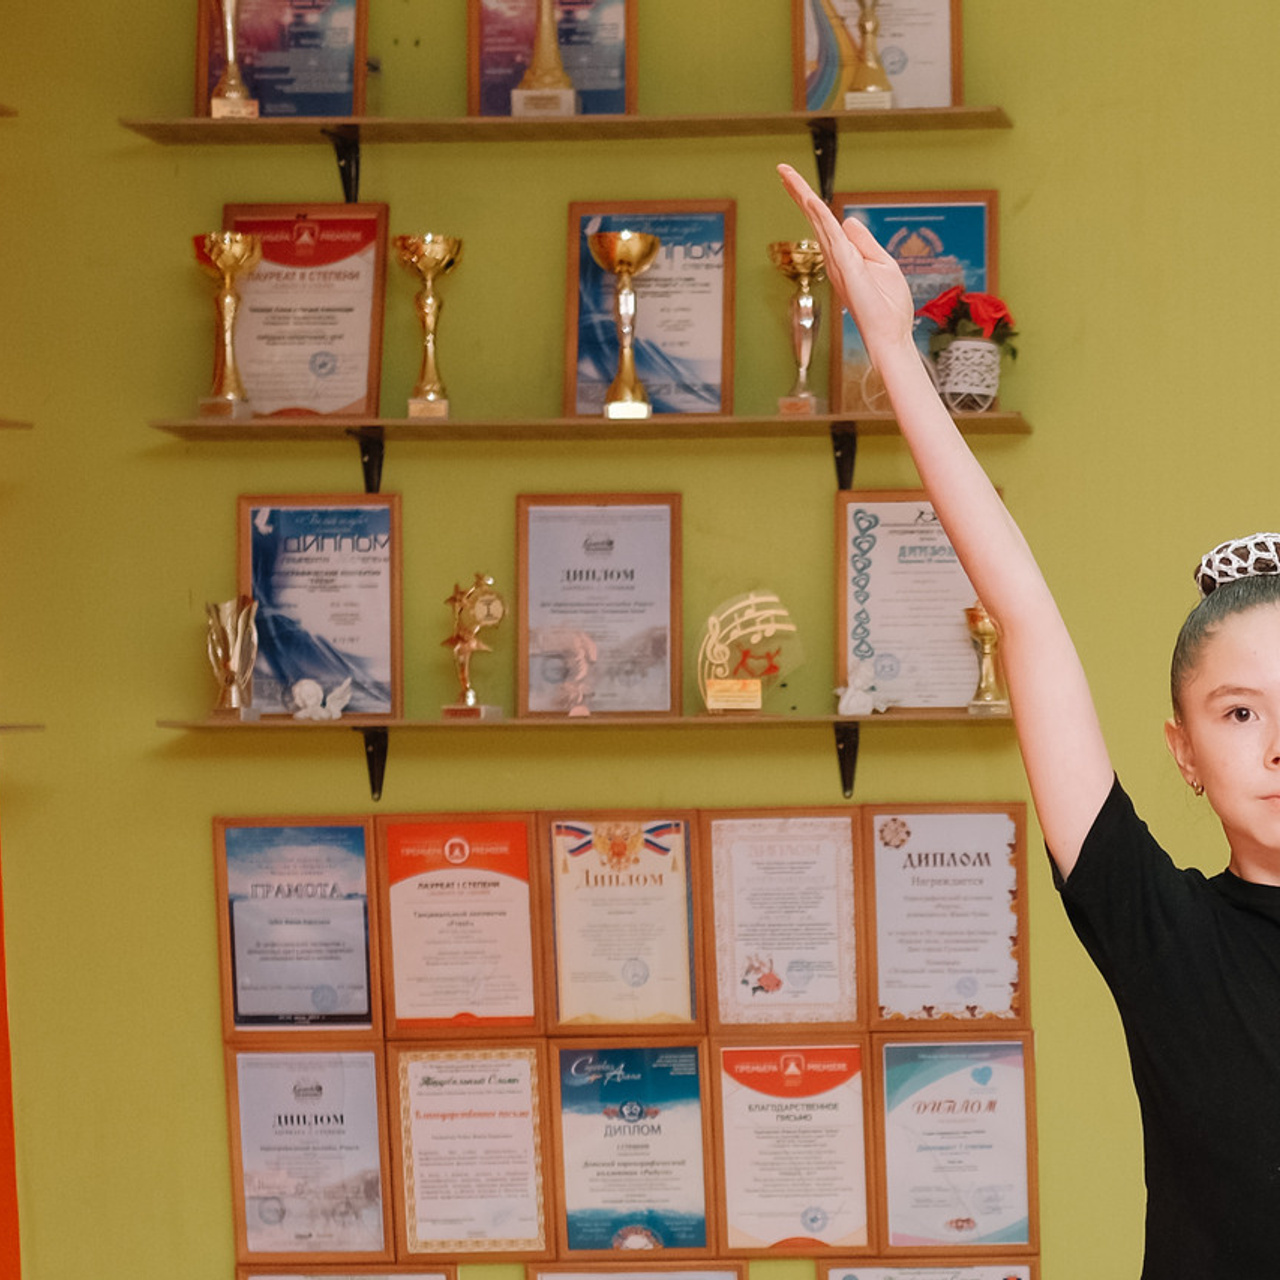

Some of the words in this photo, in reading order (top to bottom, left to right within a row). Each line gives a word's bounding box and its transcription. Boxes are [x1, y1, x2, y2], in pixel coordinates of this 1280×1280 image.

[561, 568, 635, 583] ДИПЛОМ
[902, 851, 992, 870] ДИПЛОМ
[911, 1099, 998, 1115] ДИПЛОМ
[272, 1113, 344, 1128] ДИПЛОМ
[603, 1124, 662, 1138] ДИПЛОМ
